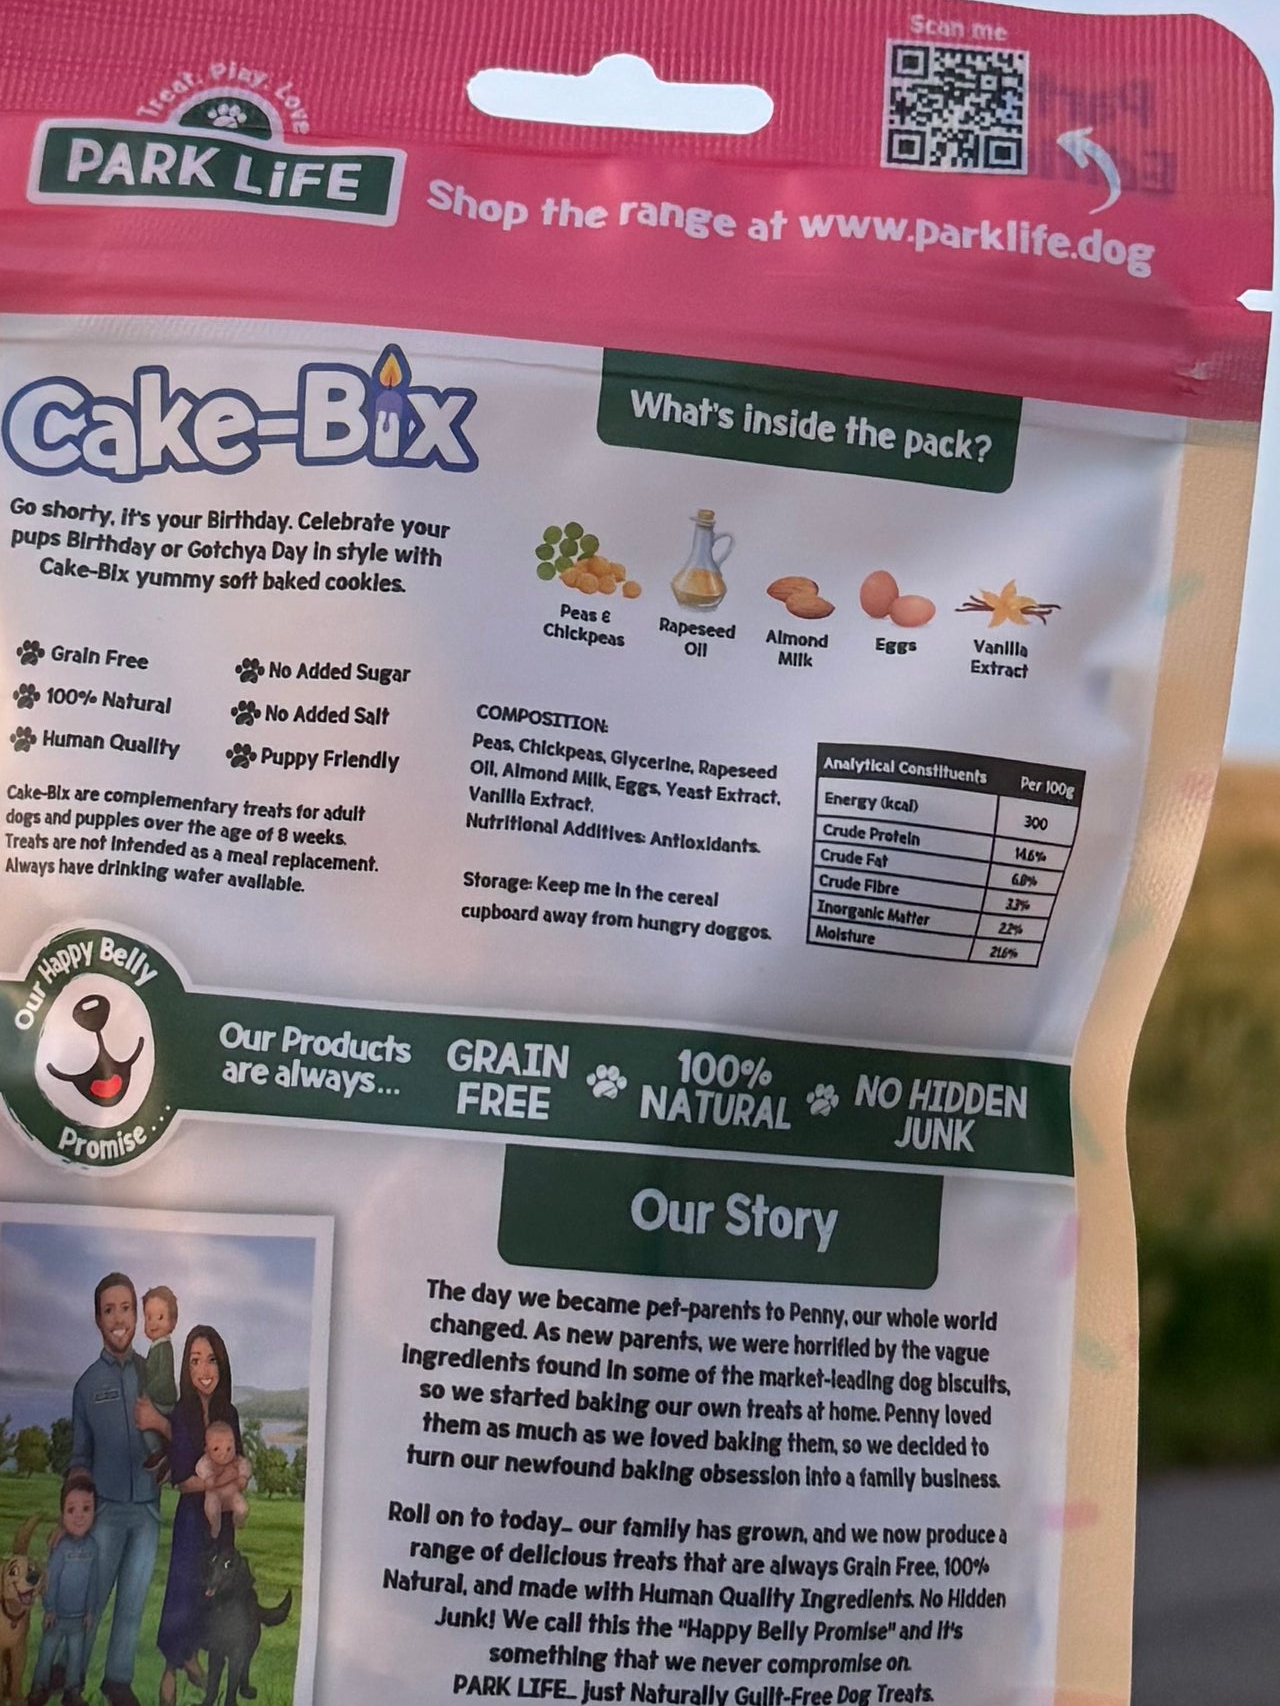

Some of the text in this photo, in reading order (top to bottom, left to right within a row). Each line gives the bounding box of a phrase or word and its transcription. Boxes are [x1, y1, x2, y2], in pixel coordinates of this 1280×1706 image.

[909, 14, 1008, 41] Scan me
[275, 81, 310, 135] Love
[67, 138, 220, 187] PARK
[427, 179, 1155, 278] Shop the range at www.parklife.dog
[1, 343, 479, 483] Cake-Bix
[631, 389, 992, 463] What's inside the pack?
[10, 497, 450, 538] Go shorty, it's your Birthday. Celebrate your
[11, 529, 442, 567] pups Birthday or Gotchya Day in style with
[40, 557, 406, 593] Cake-Bix yummy soft baked cookies.
[560, 604, 610, 623] Peas &
[544, 623, 624, 646] Chickpeas
[660, 617, 736, 639] Rapeseed
[766, 630, 828, 648] Almond
[52, 645, 148, 669] Grain Free
[685, 642, 707, 657] Oil
[778, 651, 812, 667] Milk
[876, 638, 916, 655] Eggs
[974, 639, 1028, 657] Vanilla
[269, 661, 411, 685] No Added Sugar
[971, 659, 1028, 678] Extract
[47, 687, 172, 714] 100% Natural
[265, 705, 390, 725] No Added Salt
[477, 704, 608, 733] COMPOSITION:
[43, 730, 180, 760] Human Quality
[472, 733, 777, 780] Peas, Chickpeas, Glycerine, Rapeseed
[261, 747, 400, 773] Puppy Friendly
[824, 757, 987, 784] Analytical Constituents
[470, 760, 780, 805] Oil, Almond Milk, Eggs, Yeast Extract,
[1021, 776, 1075, 799] Per 100g
[7, 784, 366, 821] Cake-Bix are complementary treats for adult
[825, 792, 918, 813] Energy (kcal)
[823, 824, 920, 846] Crude Protein
[1024, 815, 1048, 831] 300
[820, 849, 888, 868] Crude Fat
[819, 874, 899, 895] Crude Fibre
[816, 899, 931, 925] Inorganic Matter
[816, 925, 875, 945] Moisture
[14, 936, 158, 1031] Our Happy Belly
[220, 1022, 411, 1063] Our Products
[447, 1039, 569, 1079] GRAIN
[678, 1049, 772, 1089] 100%
[222, 1061, 269, 1085] are
[457, 1082, 550, 1120] FREE
[640, 1085, 791, 1129] NATURAL
[855, 1075, 1027, 1119] NO HIDDEN
[894, 1116, 975, 1152] JUNK
[631, 1188, 838, 1253] Our Story
[427, 1279, 997, 1331] The day we became pet-parents to Penny, our whole world
